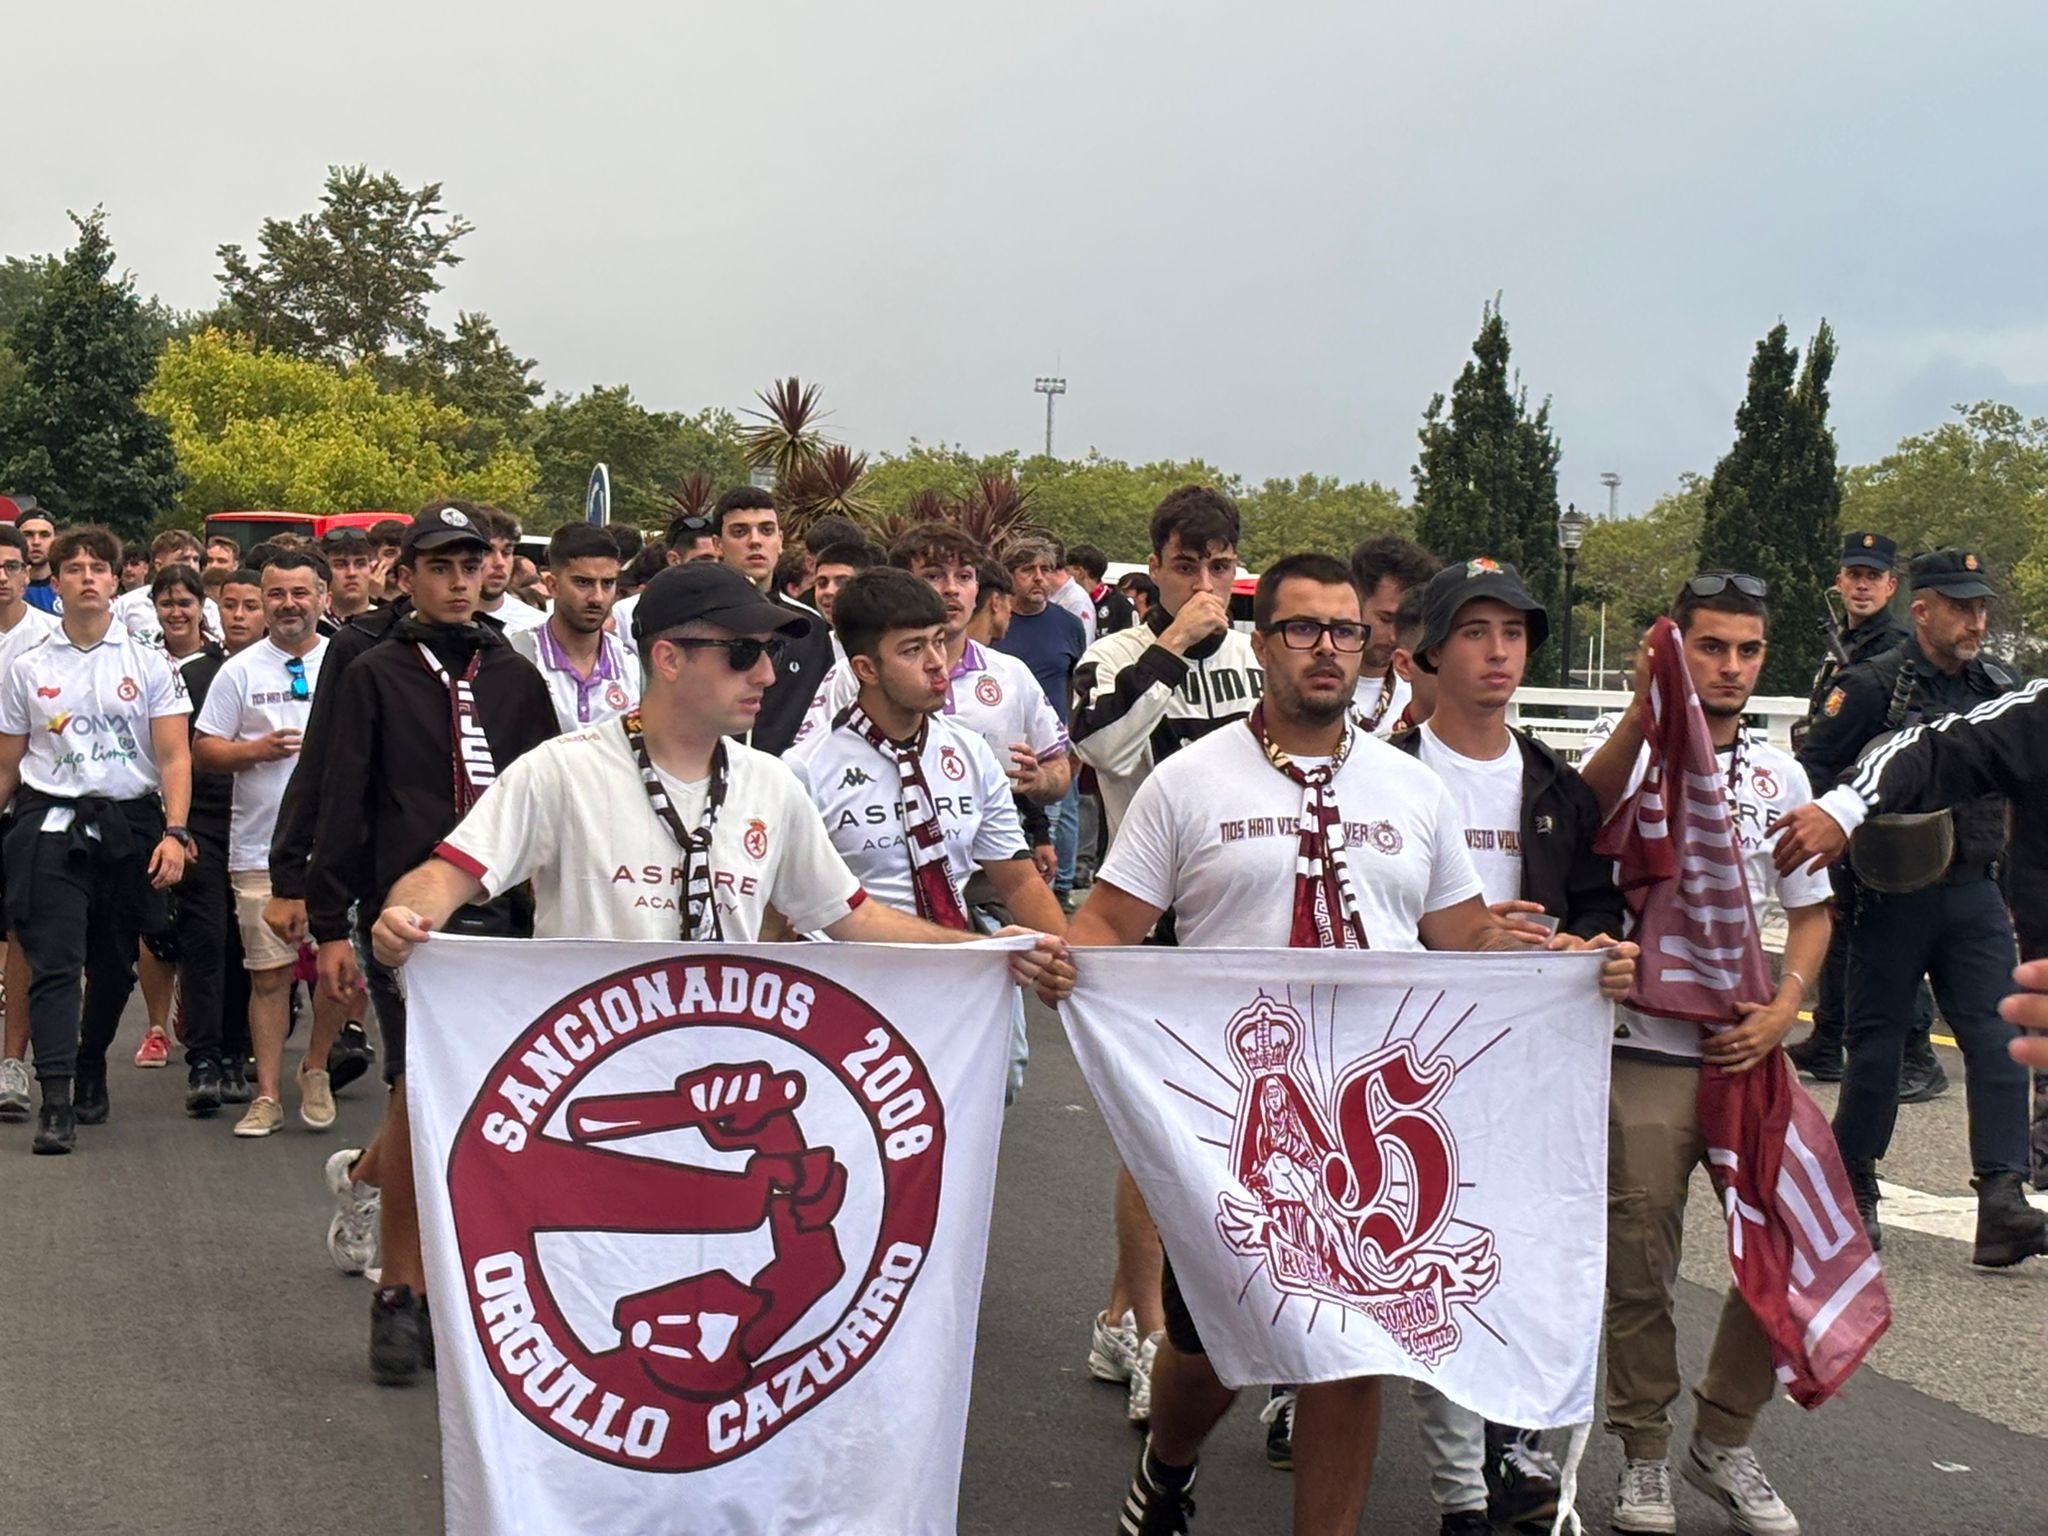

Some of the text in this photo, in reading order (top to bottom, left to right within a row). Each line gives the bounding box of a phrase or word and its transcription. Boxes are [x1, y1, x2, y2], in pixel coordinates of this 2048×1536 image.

[1180, 668, 1264, 705] UMA
[837, 796, 973, 830] ASPRE
[1277, 817, 1301, 836] VIS
[612, 865, 758, 896] ASPRE
[481, 966, 933, 1161] SANCIONADOS 2008
[474, 1241, 924, 1459] ORGULLO CAZURRO
